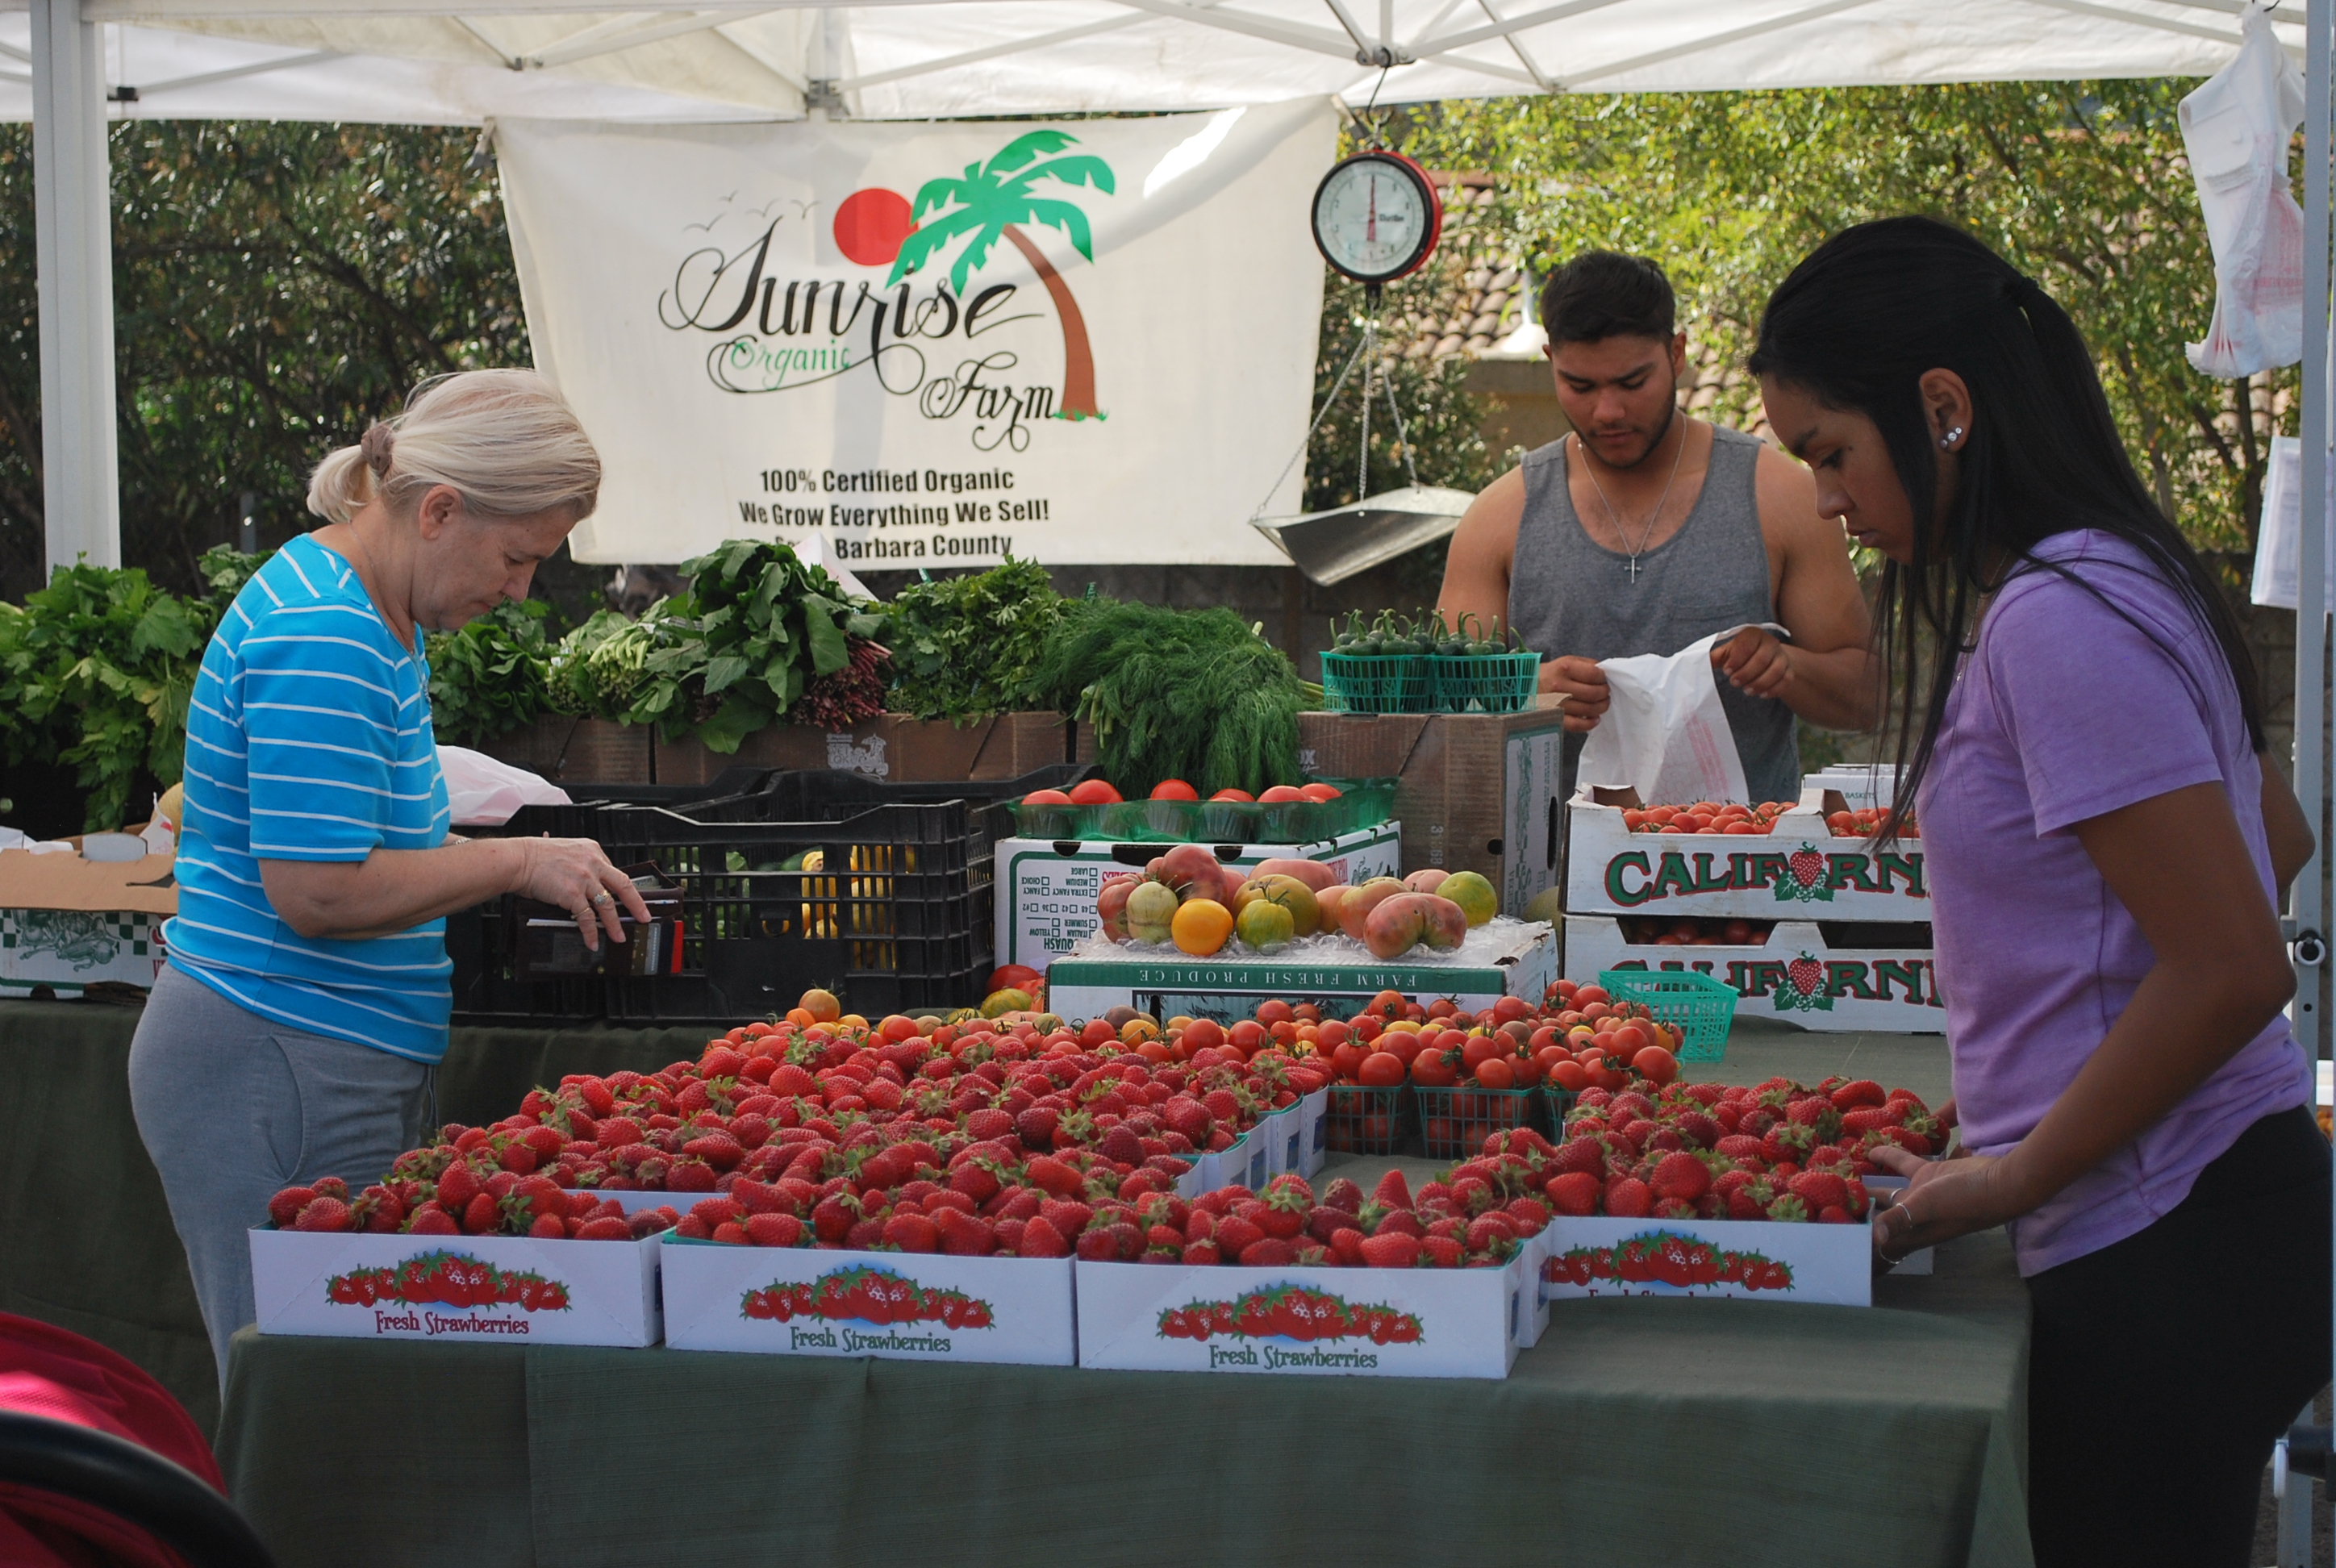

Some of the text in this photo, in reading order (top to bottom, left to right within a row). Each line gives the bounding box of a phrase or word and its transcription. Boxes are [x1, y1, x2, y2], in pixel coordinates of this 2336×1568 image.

[659, 215, 1045, 394] Sunrise
[730, 339, 851, 390] Organic
[920, 352, 1053, 452] Farm
[760, 468, 1015, 494] 100% Certified Organic
[739, 499, 1050, 528] We Grow Everything We Sell!
[835, 535, 1012, 561] Barbara County
[1071, 867, 1088, 875] LARGE
[1021, 877, 1040, 885] CHOICE
[1023, 887, 1040, 895] FANCY
[1052, 888, 1088, 897] EXTRA FANCY
[1022, 903, 1030, 911] #2
[1081, 905, 1088, 913] 48
[1065, 919, 1088, 928] SUMMER
[1029, 928, 1051, 936] YELLOW
[1066, 930, 1088, 938] ITALIAN
[1044, 937, 1078, 949] QUASH
[1139, 970, 1417, 986] FARM FRESH PRODUCE
[374, 1310, 530, 1336] Fresh Strawberries
[790, 1326, 952, 1353] Fresh Strawberries
[1208, 1345, 1378, 1370] Fresh Strawberries
